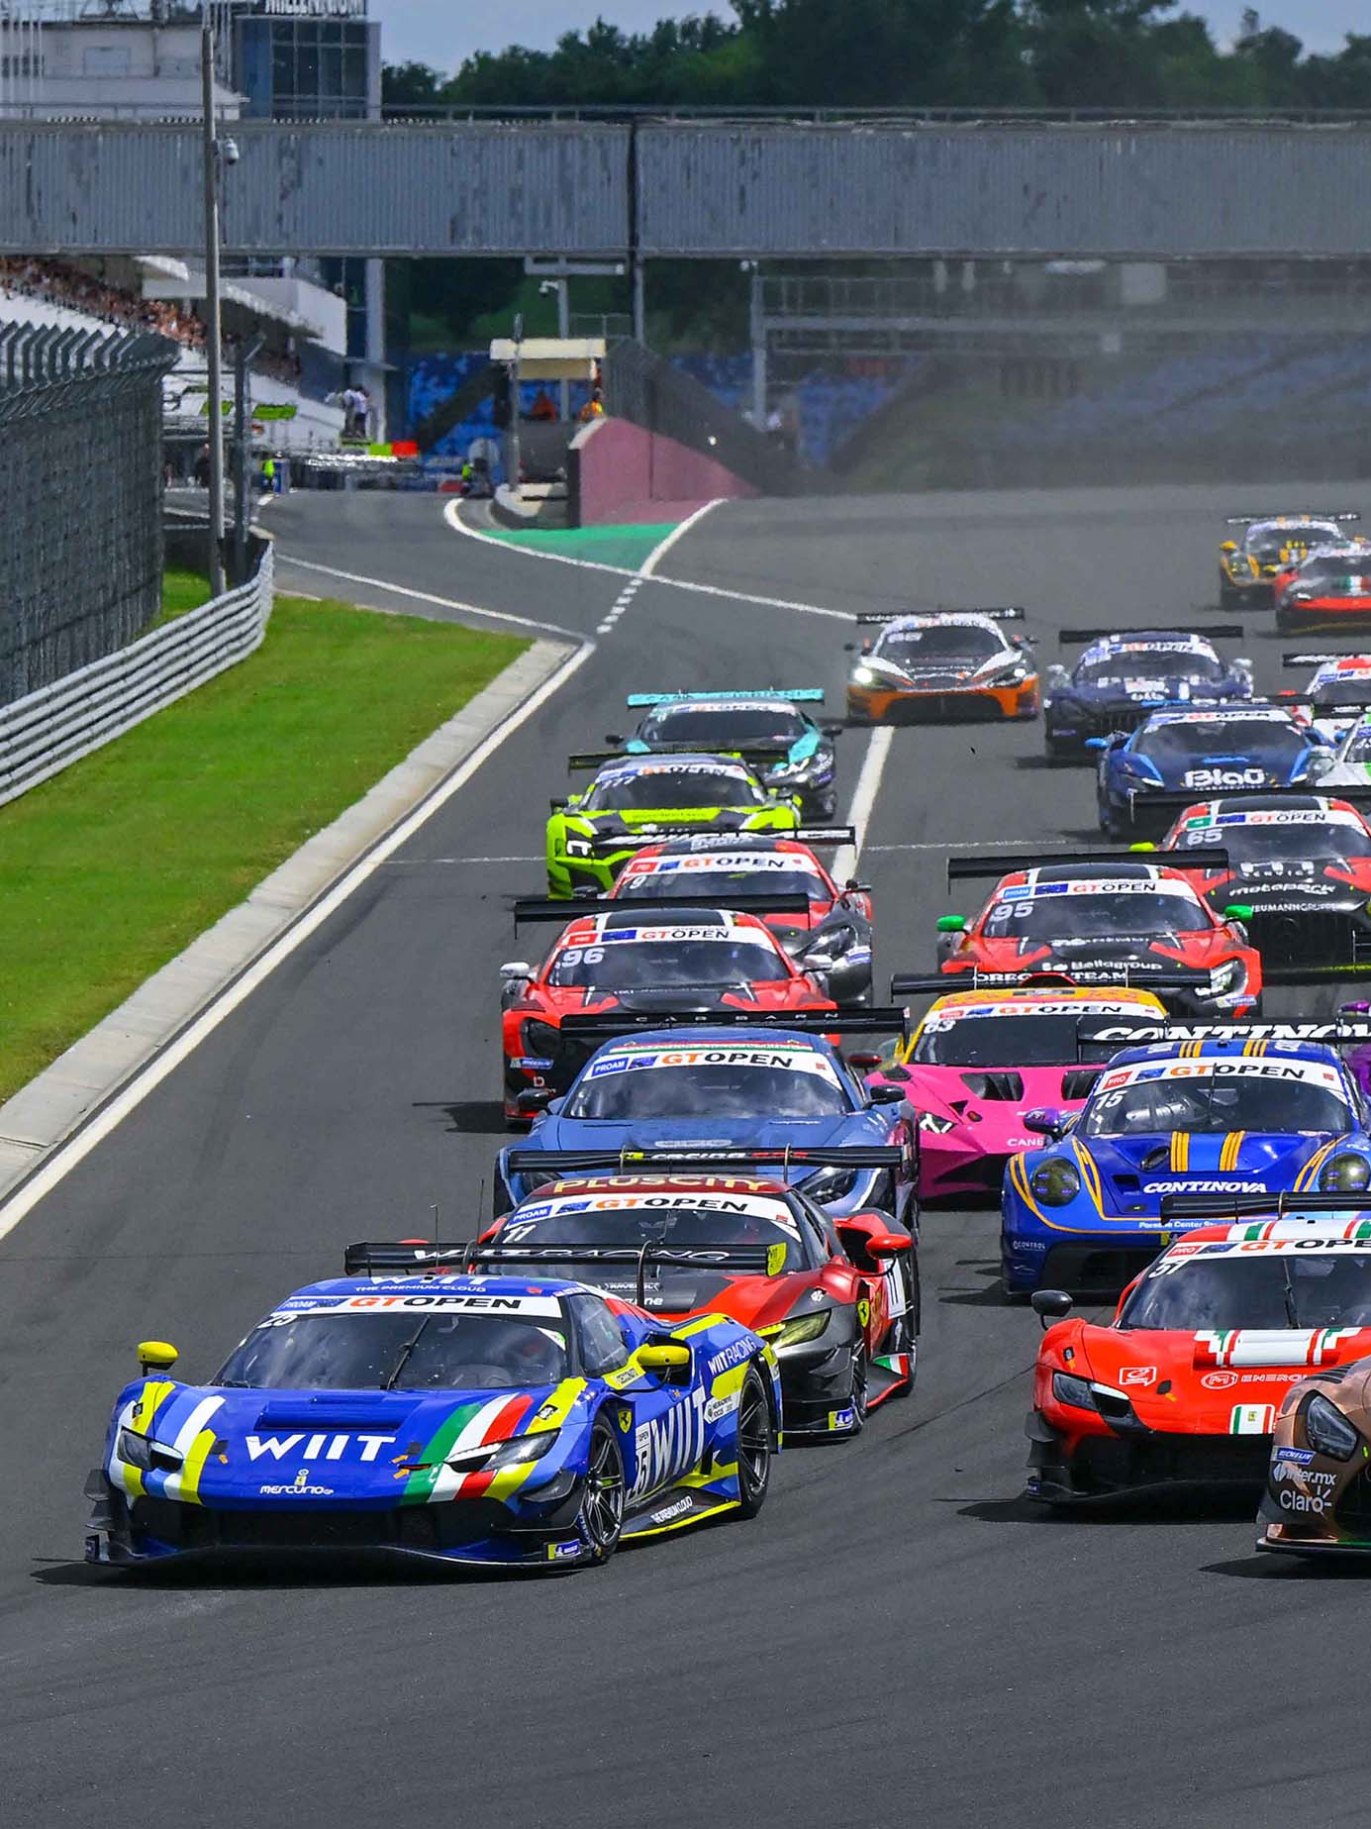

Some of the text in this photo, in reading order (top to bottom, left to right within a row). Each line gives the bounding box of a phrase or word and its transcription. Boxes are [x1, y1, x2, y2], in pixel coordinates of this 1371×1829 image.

[988, 901, 1035, 921] 95
[560, 947, 607, 968] 96
[553, 1176, 773, 1194] PLUSCITY
[1143, 1181, 1268, 1194] CONTINOVA
[246, 1434, 397, 1461] WIIT
[1280, 1489, 1324, 1513] Claro
